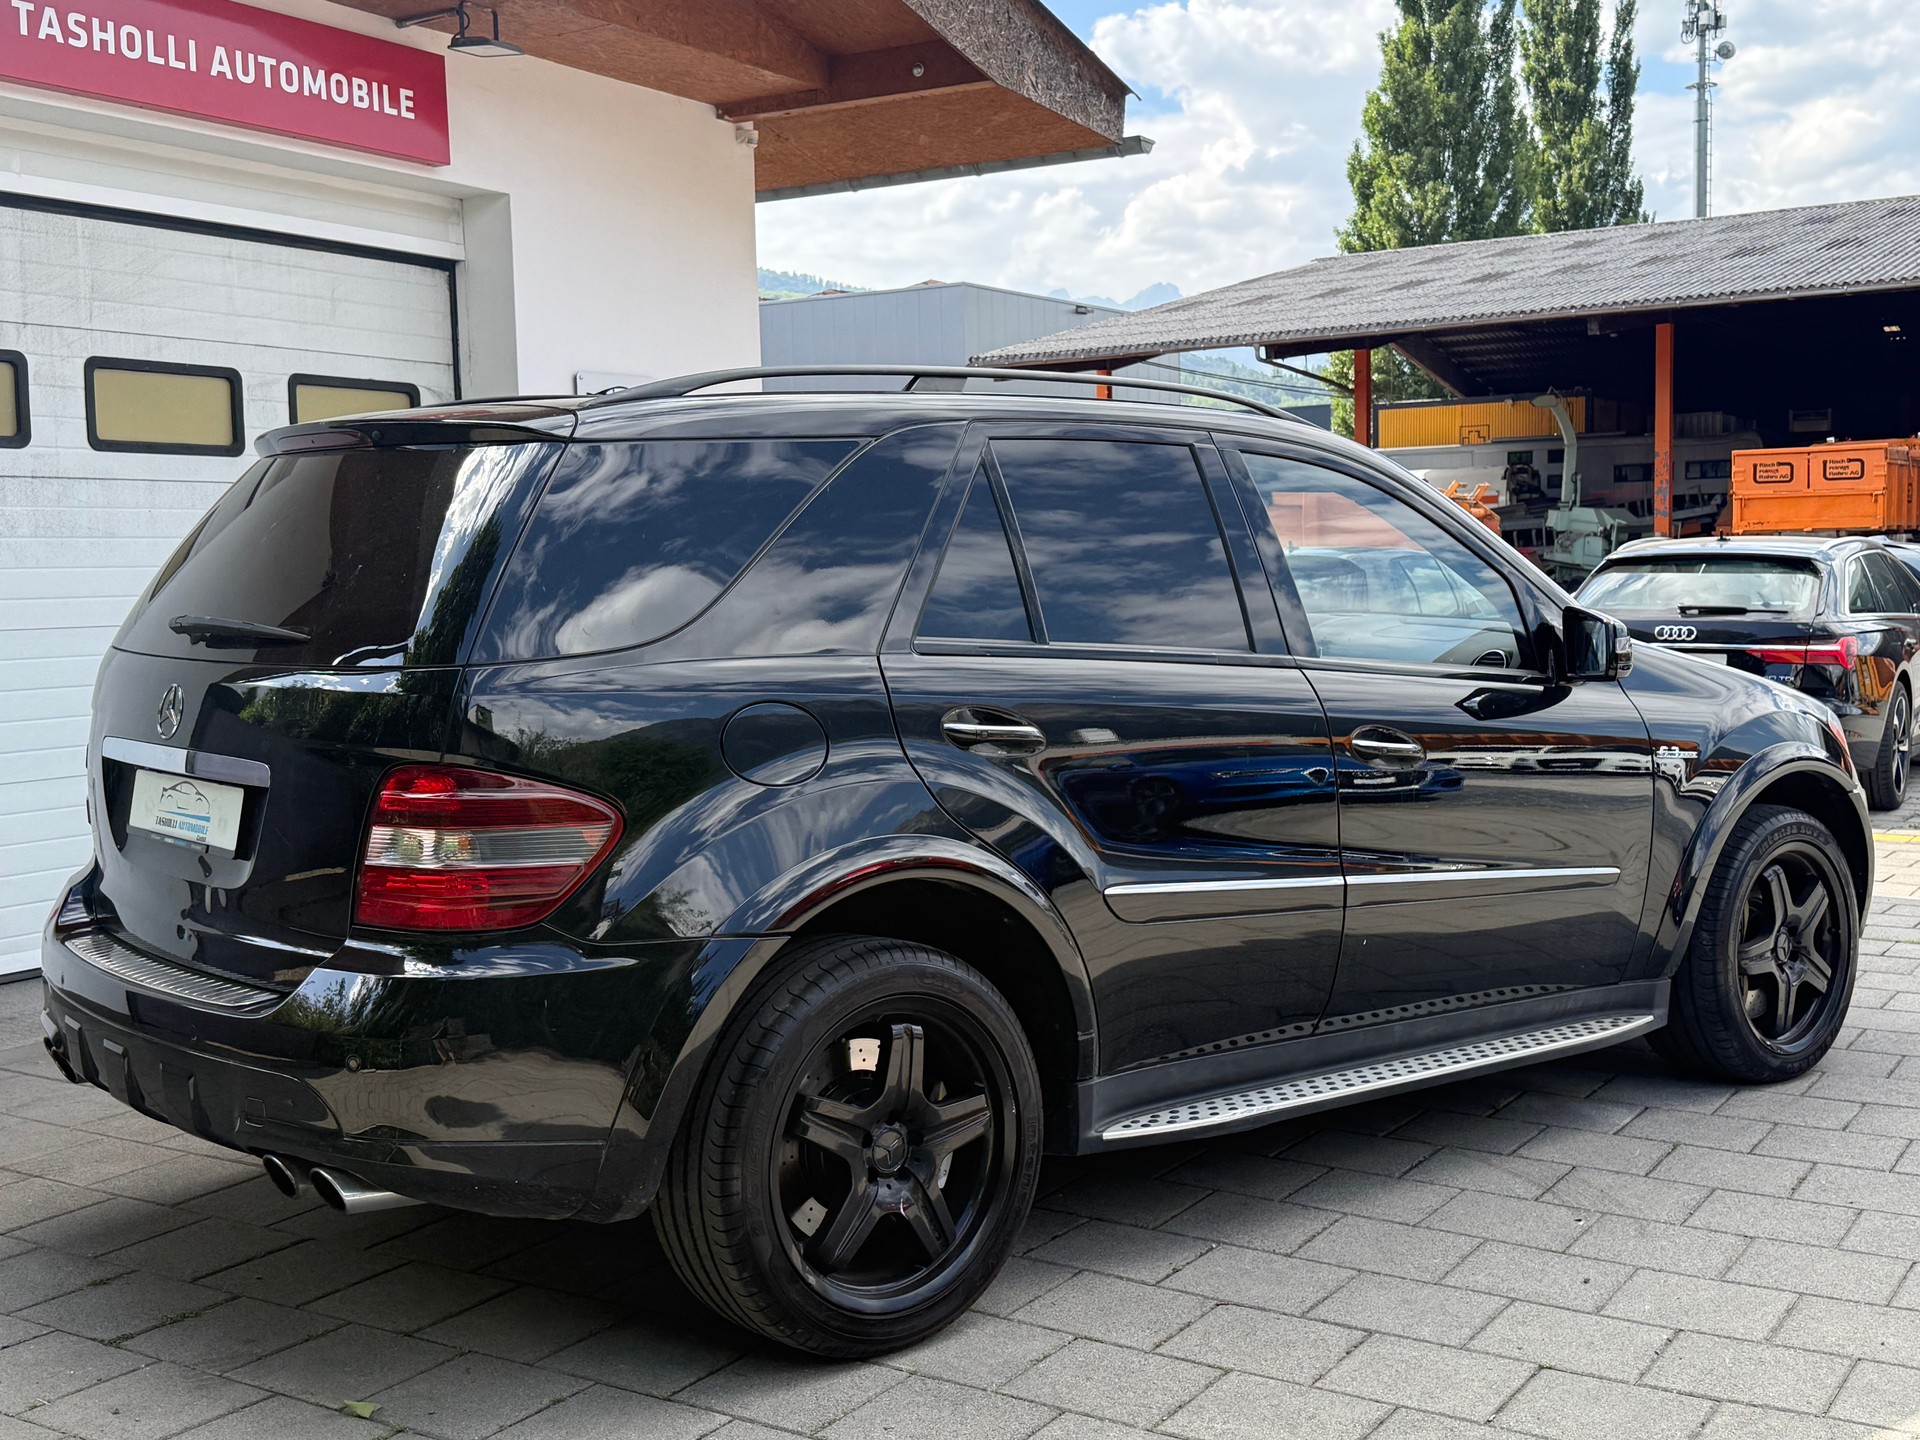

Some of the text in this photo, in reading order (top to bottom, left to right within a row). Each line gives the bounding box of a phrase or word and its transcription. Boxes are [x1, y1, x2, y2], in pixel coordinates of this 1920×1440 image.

[11, 0, 416, 120] TASHOLLI AUTOMOBILE
[156, 816, 209, 834] TASHOLLI AUTOMOBILE
